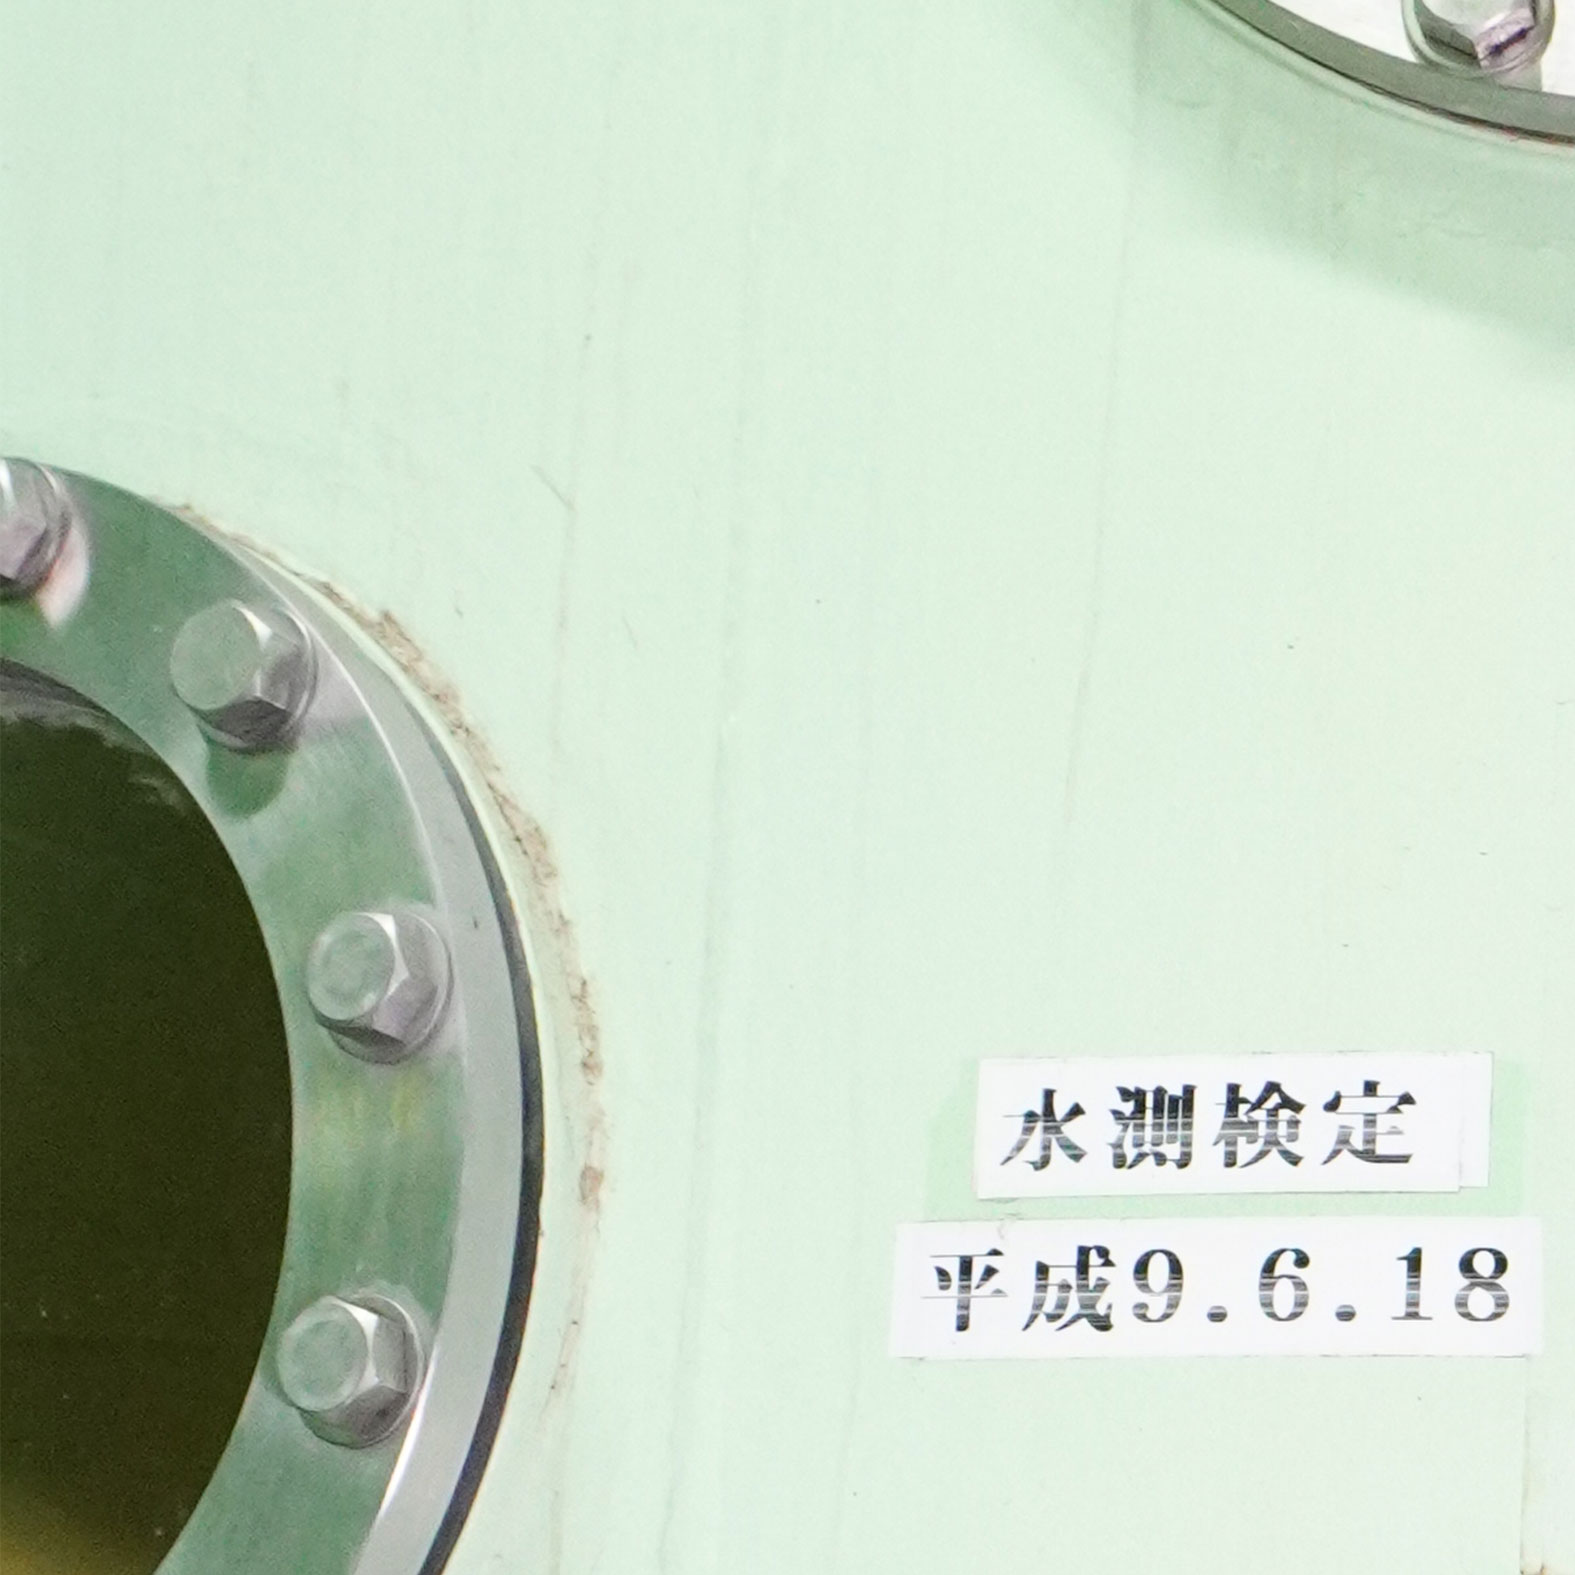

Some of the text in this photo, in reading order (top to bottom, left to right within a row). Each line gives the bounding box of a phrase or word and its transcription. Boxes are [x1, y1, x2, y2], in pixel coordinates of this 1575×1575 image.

[1000, 1079, 1417, 1172] 水測検定
[920, 1242, 1513, 1335] 平成9.6.18
